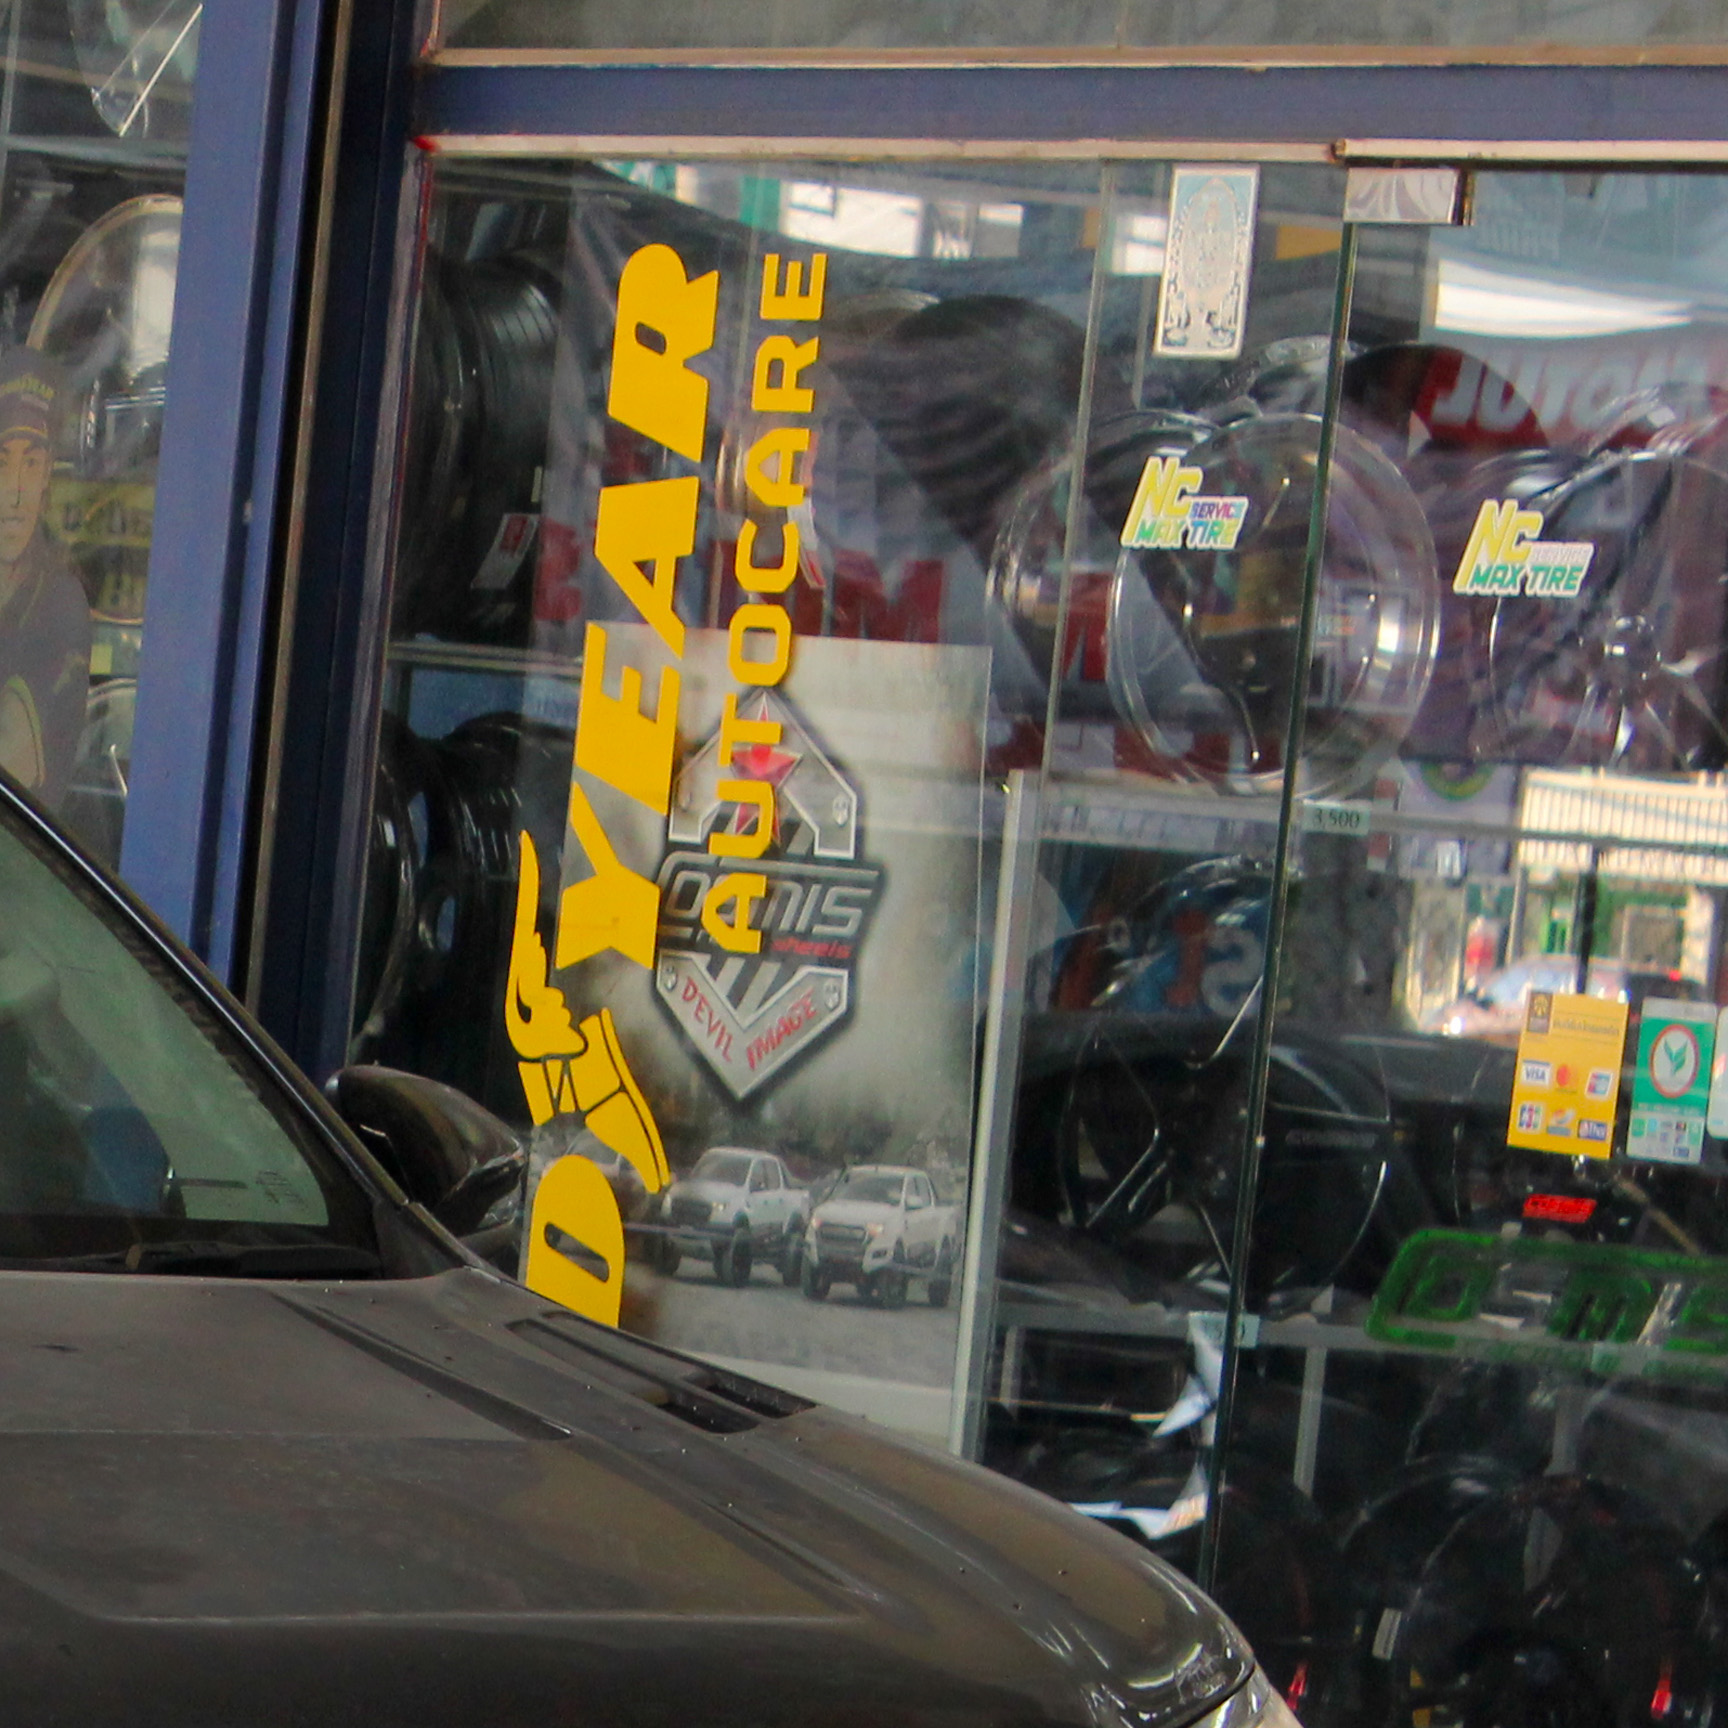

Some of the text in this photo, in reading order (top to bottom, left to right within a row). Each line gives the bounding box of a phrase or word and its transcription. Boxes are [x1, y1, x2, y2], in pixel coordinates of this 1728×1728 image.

[1123, 457, 1202, 547] NC
[1137, 519, 1239, 546] MAX TIRE
[1454, 501, 1543, 594] NC
[1470, 562, 1583, 592] MAX TIRE
[701, 252, 827, 955] AUTOCARE
[681, 976, 733, 1063] DEVIL
[746, 988, 819, 1072] IMAGE
